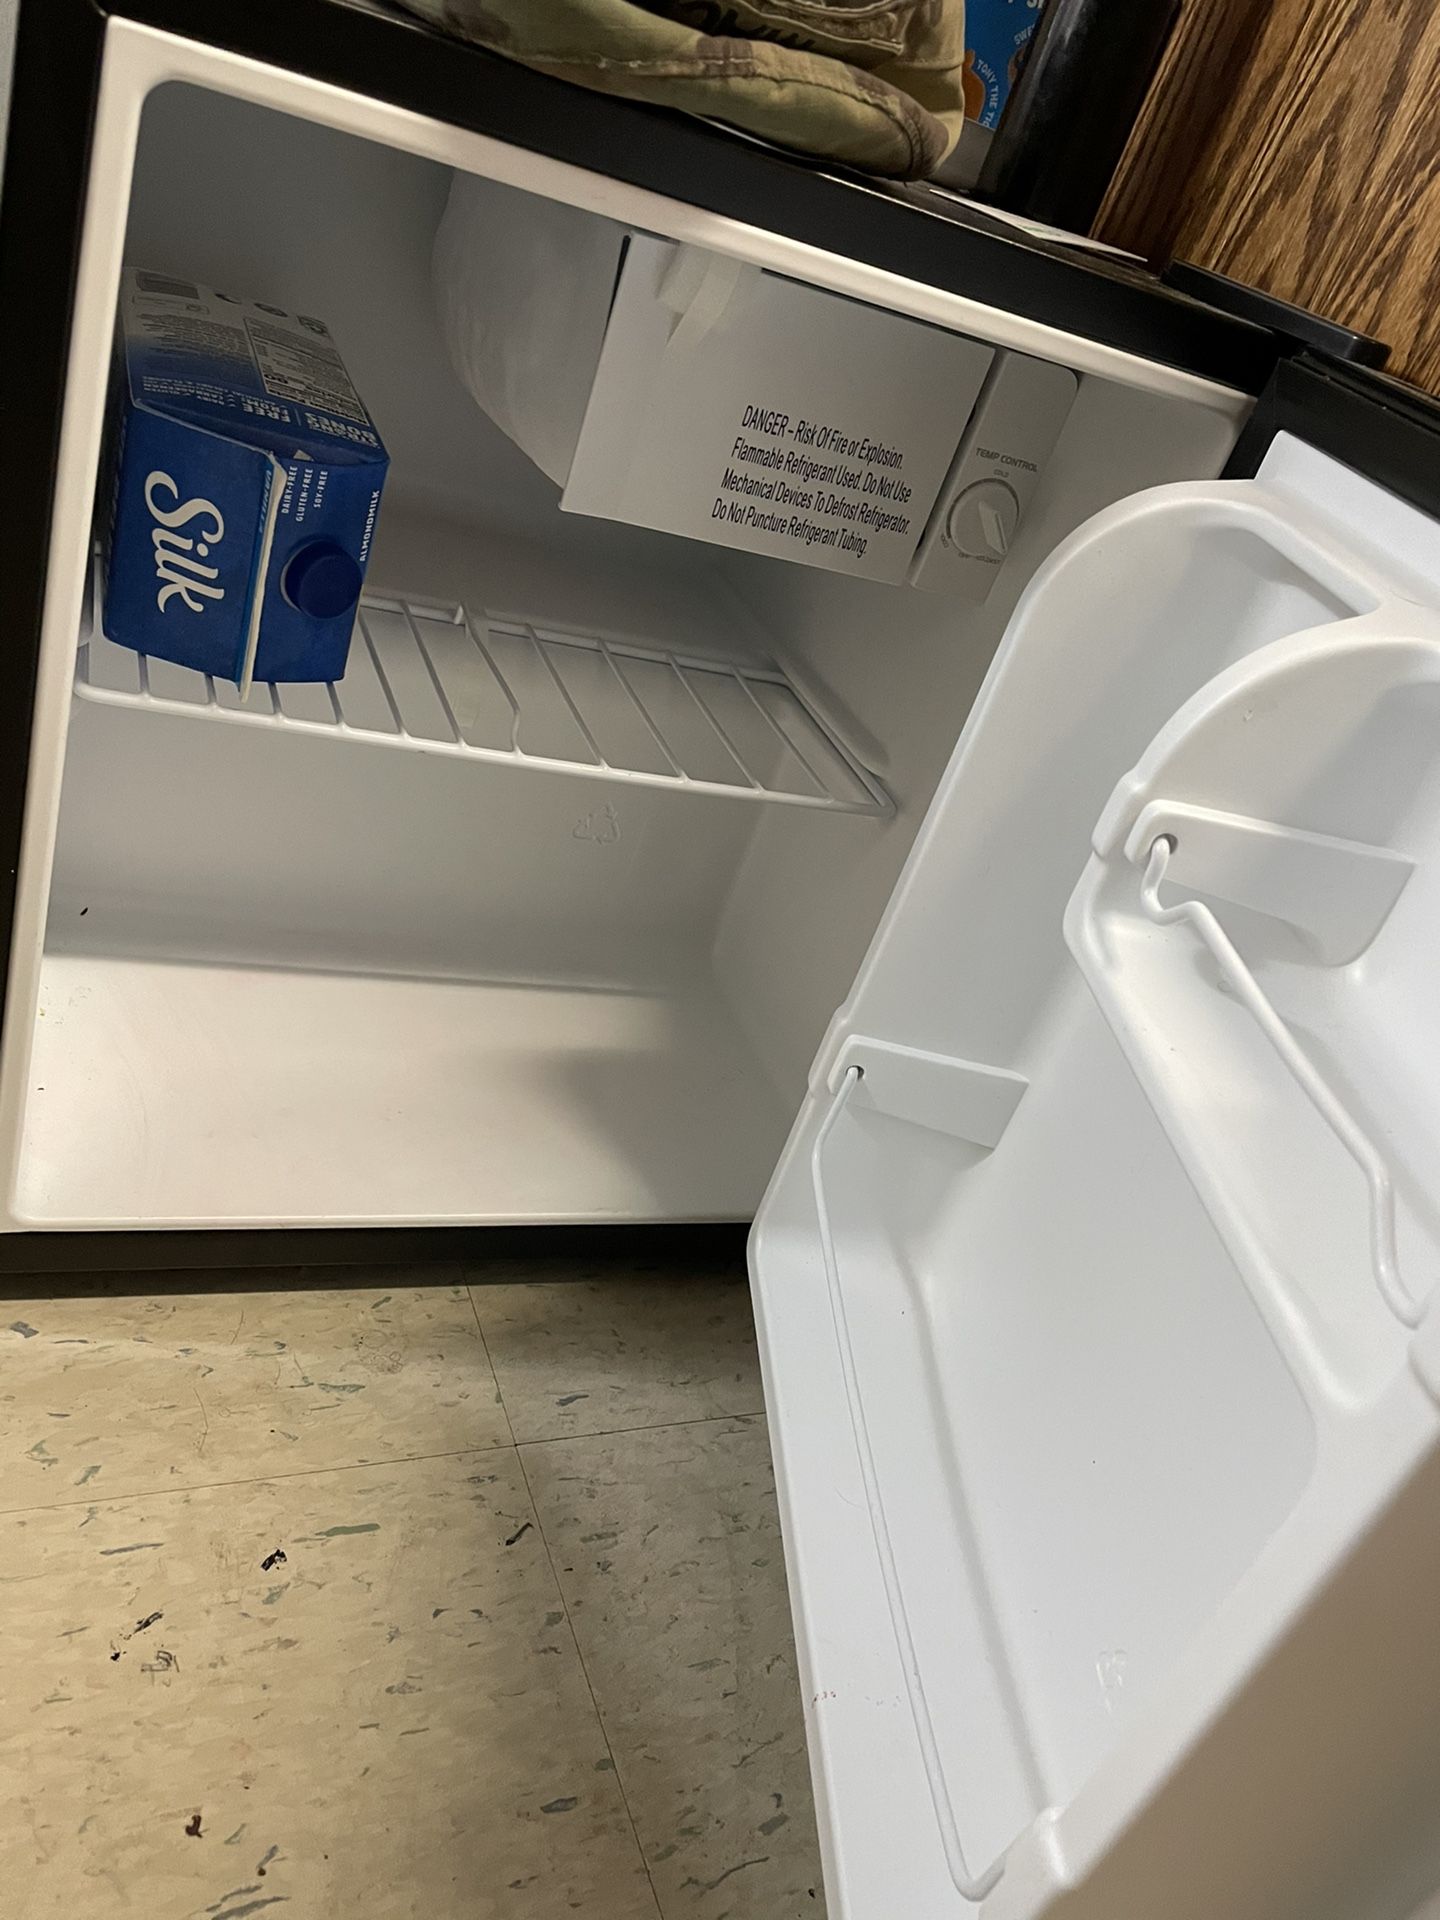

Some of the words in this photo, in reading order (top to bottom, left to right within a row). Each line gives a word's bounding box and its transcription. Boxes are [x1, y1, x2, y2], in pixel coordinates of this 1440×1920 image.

[977, 59, 997, 84] TONY
[989, 85, 999, 109] THE
[242, 402, 291, 423] FREE
[742, 405, 790, 438] DANGER
[794, 420, 818, 446] Risk
[816, 426, 833, 449] Of
[828, 429, 849, 454] Fire
[848, 441, 860, 457] or
[858, 438, 904, 470] Explosion.
[731, 436, 784, 471] Flammable
[783, 451, 838, 484] Refrigerant
[836, 464, 863, 491] Used.
[862, 472, 878, 495] Do
[875, 476, 896, 500] Not
[892, 479, 912, 503] Use
[976, 447, 1001, 461] TEMP
[1000, 454, 1039, 473] CONTROL
[359, 490, 380, 562] ALMONDMILK
[711, 498, 728, 521] Do
[726, 501, 748, 525] Not
[745, 506, 788, 534] Puncture
[786, 516, 840, 547] Refrigerant
[836, 528, 868, 559] Tubing.
[721, 467, 778, 501] Mechanical
[775, 482, 814, 510] Devices
[813, 491, 826, 513] To
[824, 494, 861, 521] Defrost
[857, 502, 911, 536] Refrigerator.
[144, 470, 225, 614] Silk
